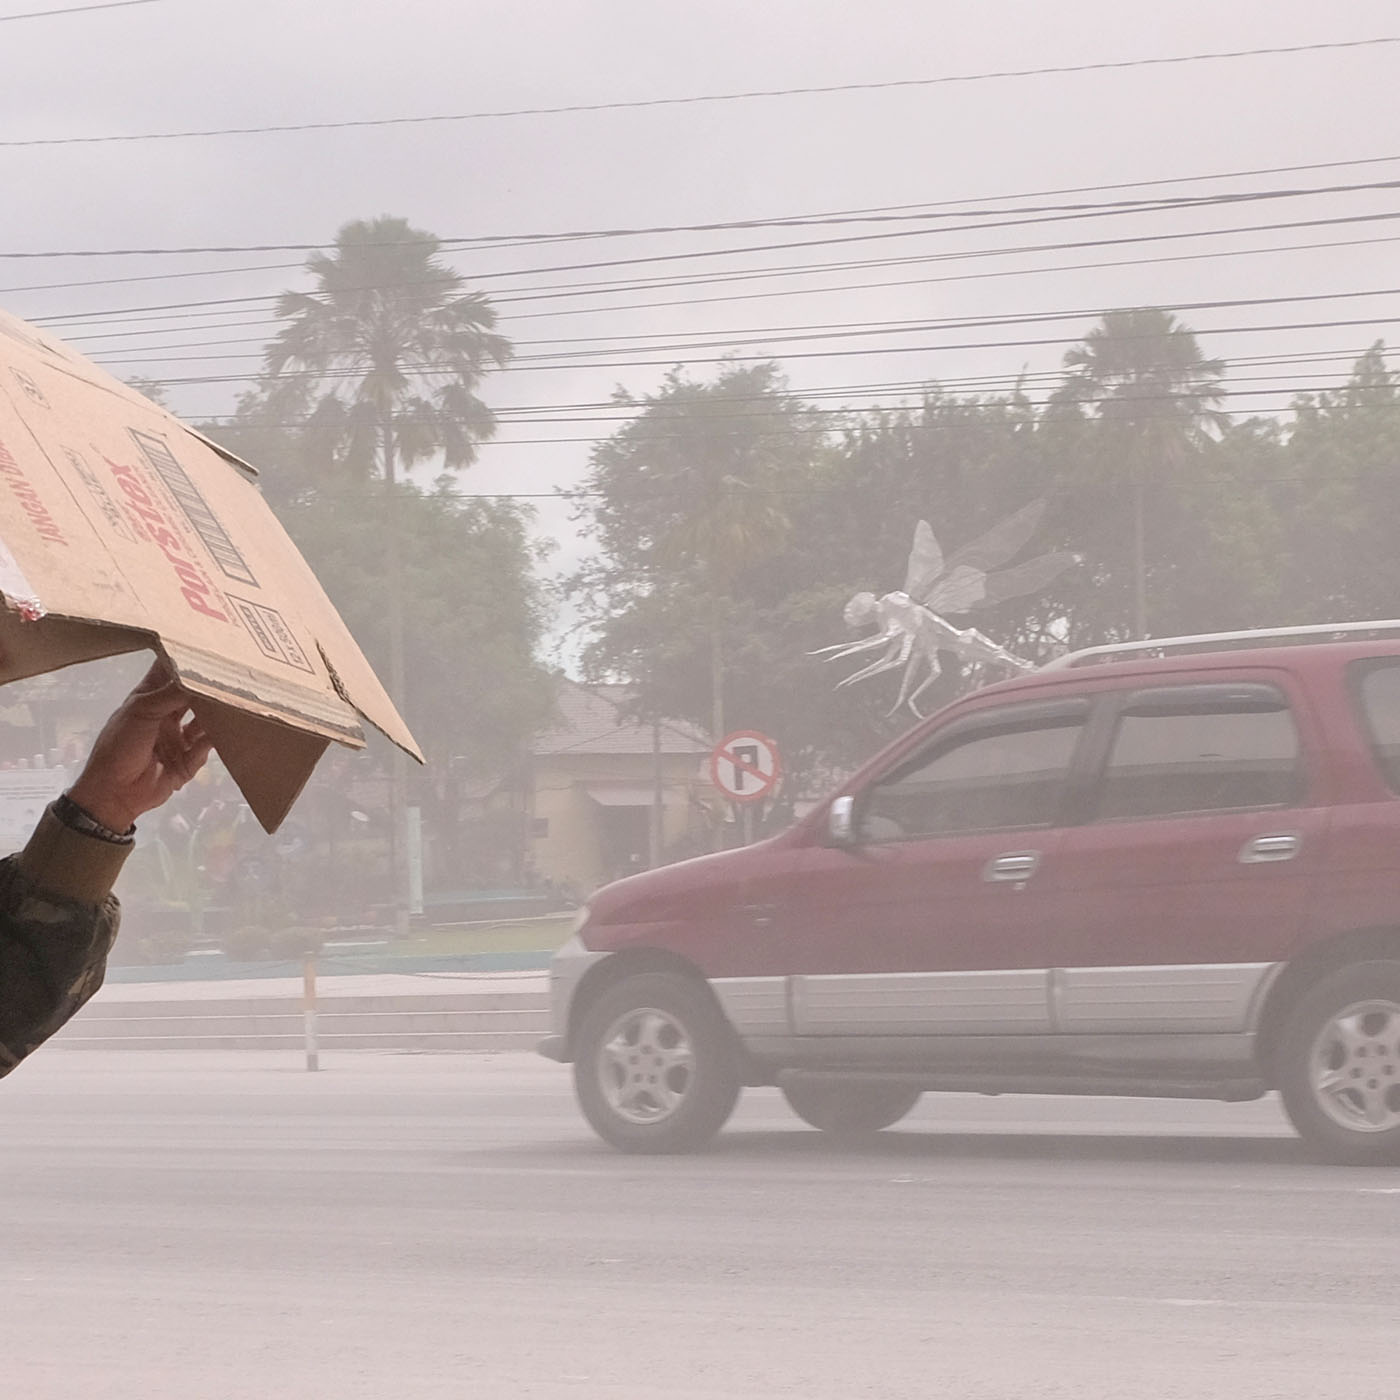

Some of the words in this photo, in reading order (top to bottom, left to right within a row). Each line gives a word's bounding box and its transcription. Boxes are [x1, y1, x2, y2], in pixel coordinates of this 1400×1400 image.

[5, 475, 71, 548] JANGAN
[99, 453, 231, 624] Porstex
[732, 745, 758, 790] P
